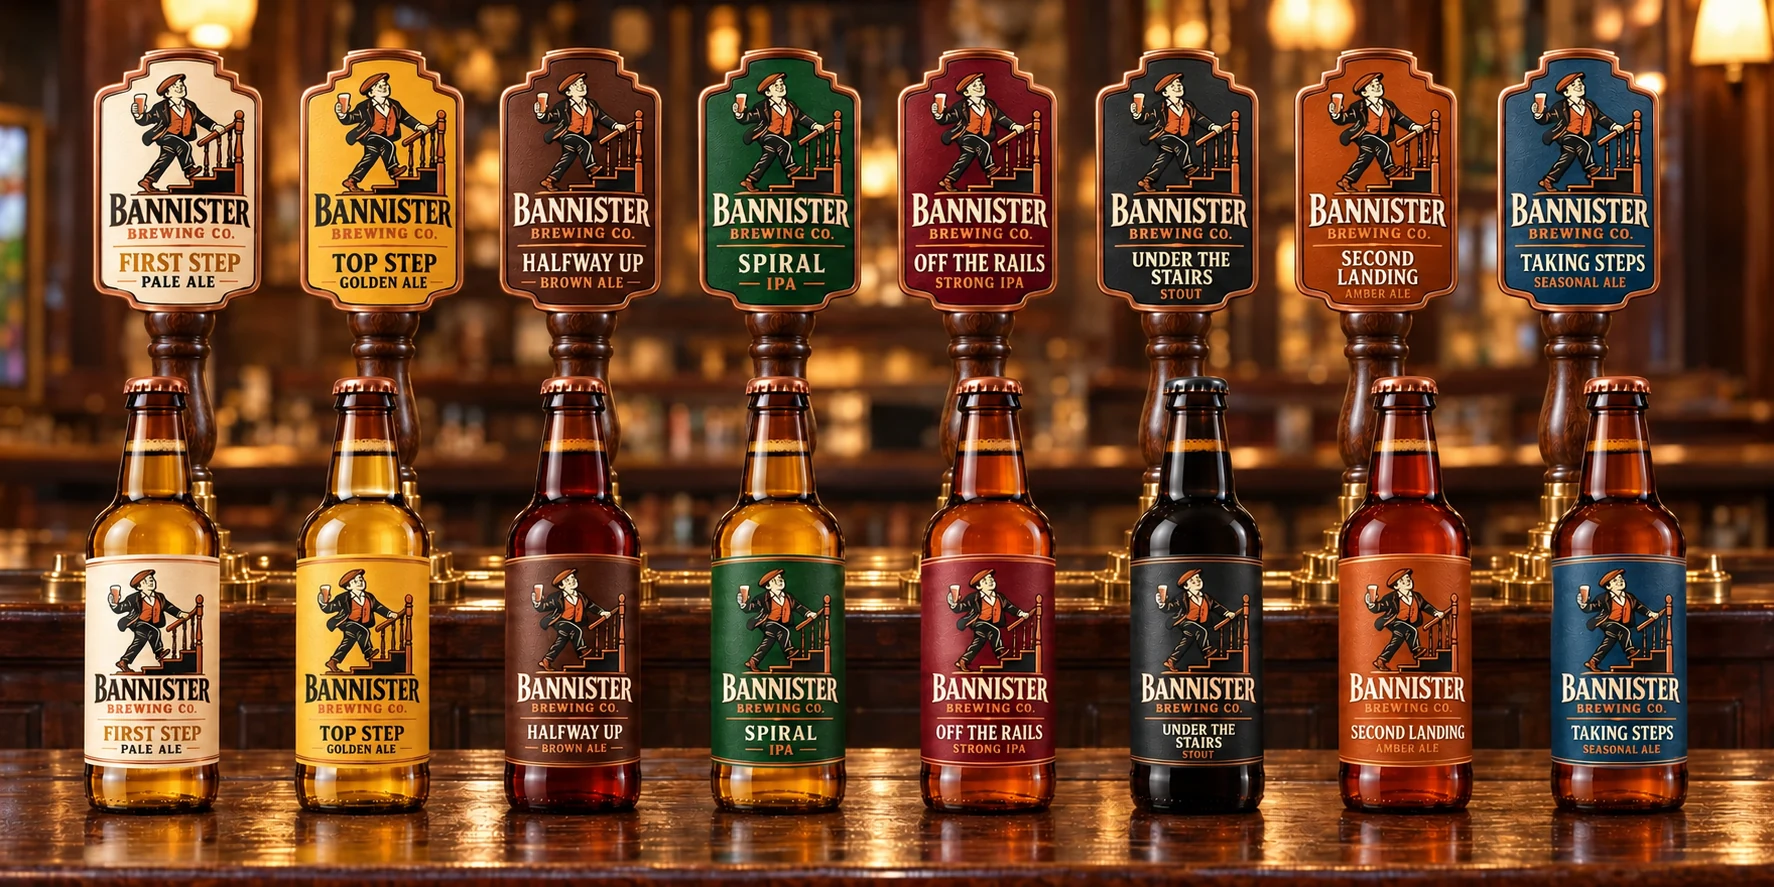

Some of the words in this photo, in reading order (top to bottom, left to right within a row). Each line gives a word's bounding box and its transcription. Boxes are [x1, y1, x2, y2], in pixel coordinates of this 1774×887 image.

[109, 194, 250, 228] BANNISTER
[314, 194, 453, 228] BANNISTER
[513, 193, 651, 227] BANNISTER
[712, 193, 850, 228] BANNISTER
[911, 193, 1049, 228] BANNISTER
[1110, 193, 1248, 228] BANNISTER
[1309, 193, 1447, 228] BANNISTER
[1511, 193, 1650, 228] BANNISTER
[127, 227, 205, 239] BREWING
[212, 227, 235, 239] CO.
[332, 227, 408, 239] BREWING
[414, 227, 437, 239] CO.
[531, 227, 605, 239] BREWING
[612, 227, 635, 239] CO.
[730, 227, 805, 239] BREWING
[811, 227, 834, 239] CO.
[929, 227, 1003, 239] BREWING
[1009, 227, 1032, 239] CO.
[1129, 227, 1203, 239] BREWING
[1209, 227, 1232, 239] CO.
[1327, 227, 1402, 239] BREWING
[1408, 227, 1431, 239] CO.
[1529, 227, 1604, 239] BREWING
[1610, 227, 1633, 239] CO.
[120, 253, 184, 272] FIRST
[189, 253, 241, 272] STEP
[332, 253, 378, 272] TOP
[385, 253, 437, 272] STEP
[522, 253, 615, 272] HALFWAY
[619, 253, 643, 272] UP
[739, 253, 826, 274] SPIRAL
[914, 253, 949, 272] OFF
[953, 253, 989, 272] THE
[994, 253, 1045, 272] RAILS
[1132, 251, 1192, 267] UNDER
[1196, 251, 1230, 267] THE
[1342, 250, 1414, 266] SECOND
[1520, 253, 1591, 272] TAKING
[1595, 253, 1645, 272] STEPS
[142, 276, 182, 288] PALE
[187, 276, 215, 288] ALE
[340, 276, 397, 289] GOLDEN
[401, 276, 427, 289] ALE
[541, 277, 593, 289] BROWN
[598, 277, 623, 289] ALE
[767, 277, 796, 290] IPA
[936, 277, 995, 289] STRONG
[1000, 277, 1024, 289] IPA
[1151, 269, 1213, 285] STAIRS
[1337, 268, 1418, 286] LANDING
[1534, 276, 1599, 288] SEASONAL
[1604, 276, 1626, 288] ALE
[1160, 289, 1202, 299] STOUT
[1345, 289, 1386, 299] AMBER
[1389, 289, 1411, 299] ALE
[94, 674, 210, 703] BANNISTER
[305, 674, 420, 703] BANNISTER
[517, 673, 633, 703] BANNISTER
[723, 673, 839, 703] BANNISTER
[932, 673, 1049, 703] BANNISTER
[1141, 673, 1256, 703] BANNISTER
[1349, 673, 1466, 703] BANNISTER
[1561, 673, 1680, 704] BANNISTER
[107, 704, 172, 714] BREWING
[178, 704, 197, 714] CO.
[318, 704, 382, 714] BREWING
[388, 704, 407, 714] CO.
[531, 703, 594, 713] BREWING
[600, 703, 619, 713] CO.
[737, 703, 801, 713] BREWING
[806, 703, 824, 713] CO.
[946, 703, 1010, 713] BREWING
[1016, 703, 1035, 713] CO.
[1156, 703, 1219, 713] BREWING
[1224, 703, 1242, 713] CO.
[1365, 703, 1428, 713] BREWING
[1433, 703, 1452, 713] CO.
[1577, 703, 1641, 714] BREWING
[1647, 703, 1666, 714] CO.
[104, 726, 156, 742] FIRST
[161, 726, 202, 742] STEP
[320, 726, 357, 742] TOP
[362, 726, 404, 742] STEP
[527, 725, 600, 740] HALFWAY
[604, 725, 623, 740] UP
[745, 725, 817, 741] SPIRAL
[936, 725, 964, 740] OFF
[967, 725, 998, 740] THE
[1001, 725, 1043, 740] RAILS
[1162, 724, 1207, 736] UNDER
[1210, 724, 1236, 736] THE
[1351, 725, 1405, 740] SECOND
[1409, 725, 1465, 741] LANDING
[1571, 725, 1629, 741] TAKING
[1633, 725, 1674, 741] STEPS
[121, 745, 154, 754] PALE
[159, 745, 182, 754] ALE
[542, 744, 584, 754] BROWN
[587, 744, 607, 754] ALE
[953, 744, 1001, 754] STRONG
[1006, 744, 1026, 754] IPA
[1176, 737, 1222, 749] STAIRS
[1376, 744, 1414, 754] AMBER
[1419, 744, 1439, 754] ALE
[327, 745, 372, 755] GOLDEN
[376, 745, 396, 755] ALE
[769, 745, 794, 756] IPA
[1182, 750, 1214, 759] STOUT
[1582, 745, 1638, 755] SEASONAL
[1641, 745, 1661, 755] ALE
